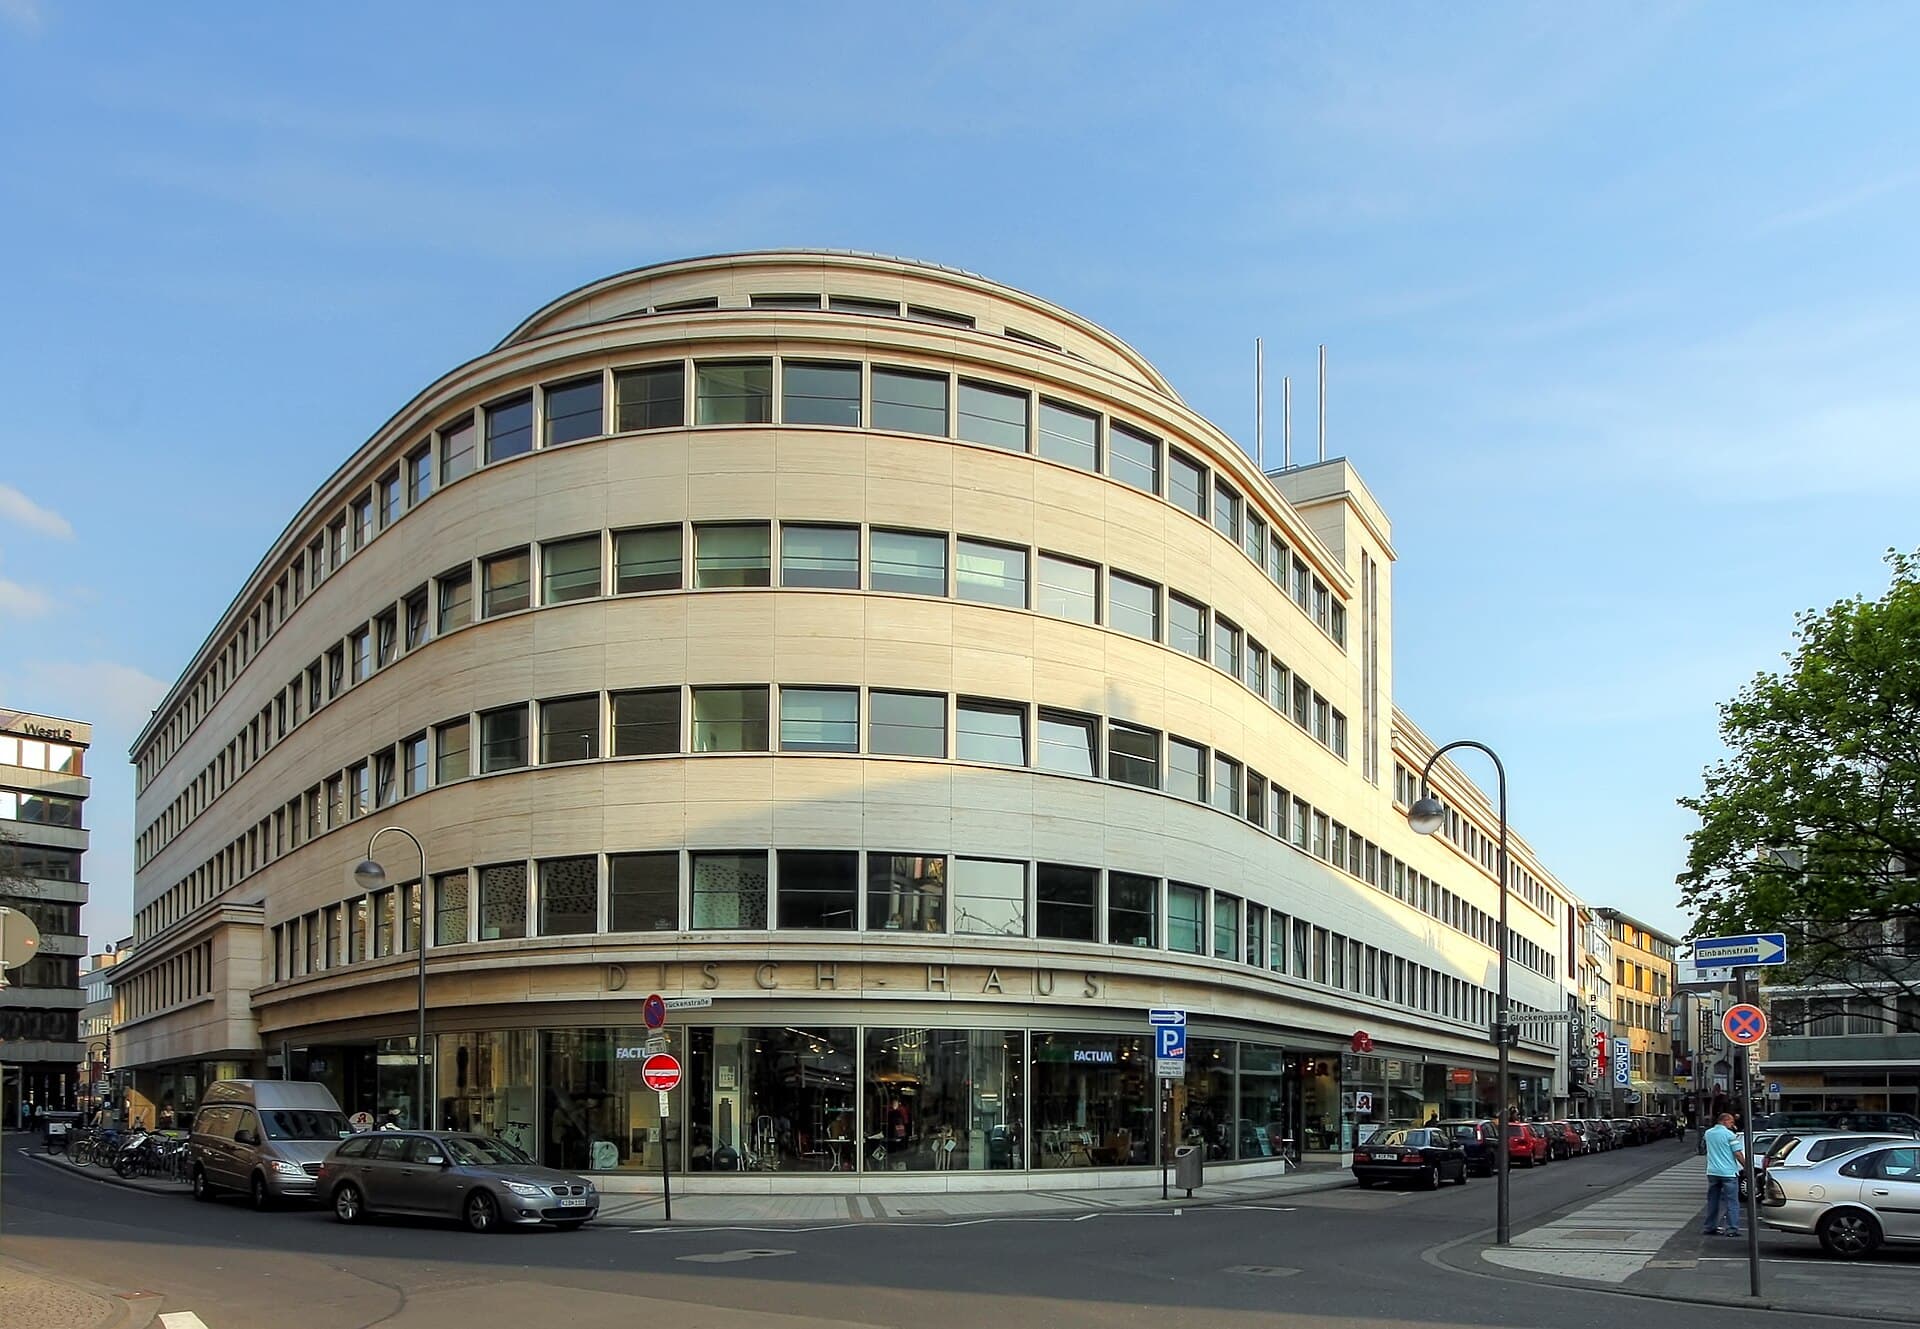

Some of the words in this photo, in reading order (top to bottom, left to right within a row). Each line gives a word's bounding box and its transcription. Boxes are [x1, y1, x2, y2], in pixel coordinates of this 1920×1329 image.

[1699, 946, 1758, 958] Einbahnstraße
[665, 998, 709, 1009] rückenstraße
[1510, 1014, 1569, 1022] Glockengasse
[1571, 1017, 1580, 1056] OPTIK
[1590, 994, 1598, 1078] BERGHFF
[1162, 1030, 1179, 1056] P
[616, 1047, 652, 1059] FACTU
[1073, 1050, 1113, 1062] FACTUM
[1616, 1041, 1628, 1083] CABINET
